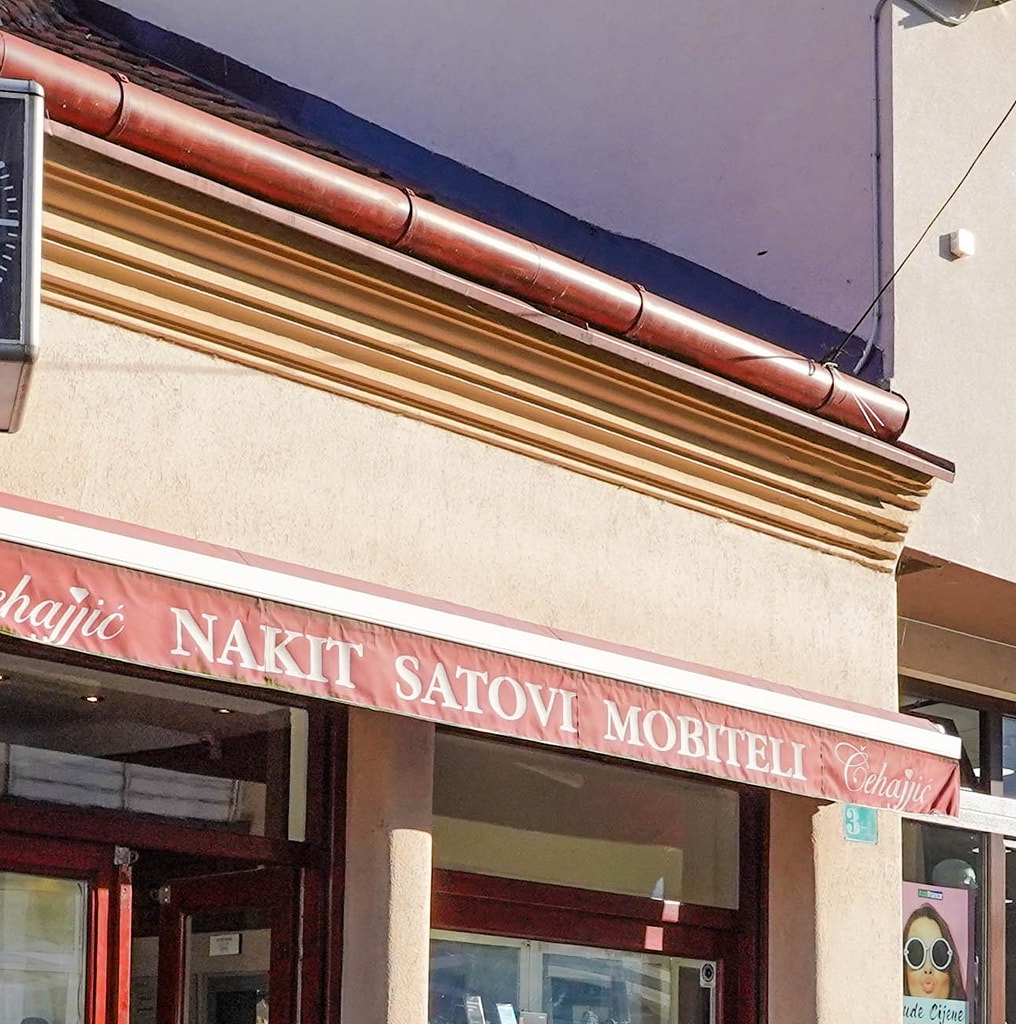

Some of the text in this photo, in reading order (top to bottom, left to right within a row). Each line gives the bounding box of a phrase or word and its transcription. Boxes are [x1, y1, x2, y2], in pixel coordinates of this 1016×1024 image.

[170, 607, 364, 689] NAKIT
[395, 655, 578, 733] SATOVI
[603, 699, 808, 781] MOBITELI
[845, 807, 861, 835] 3
